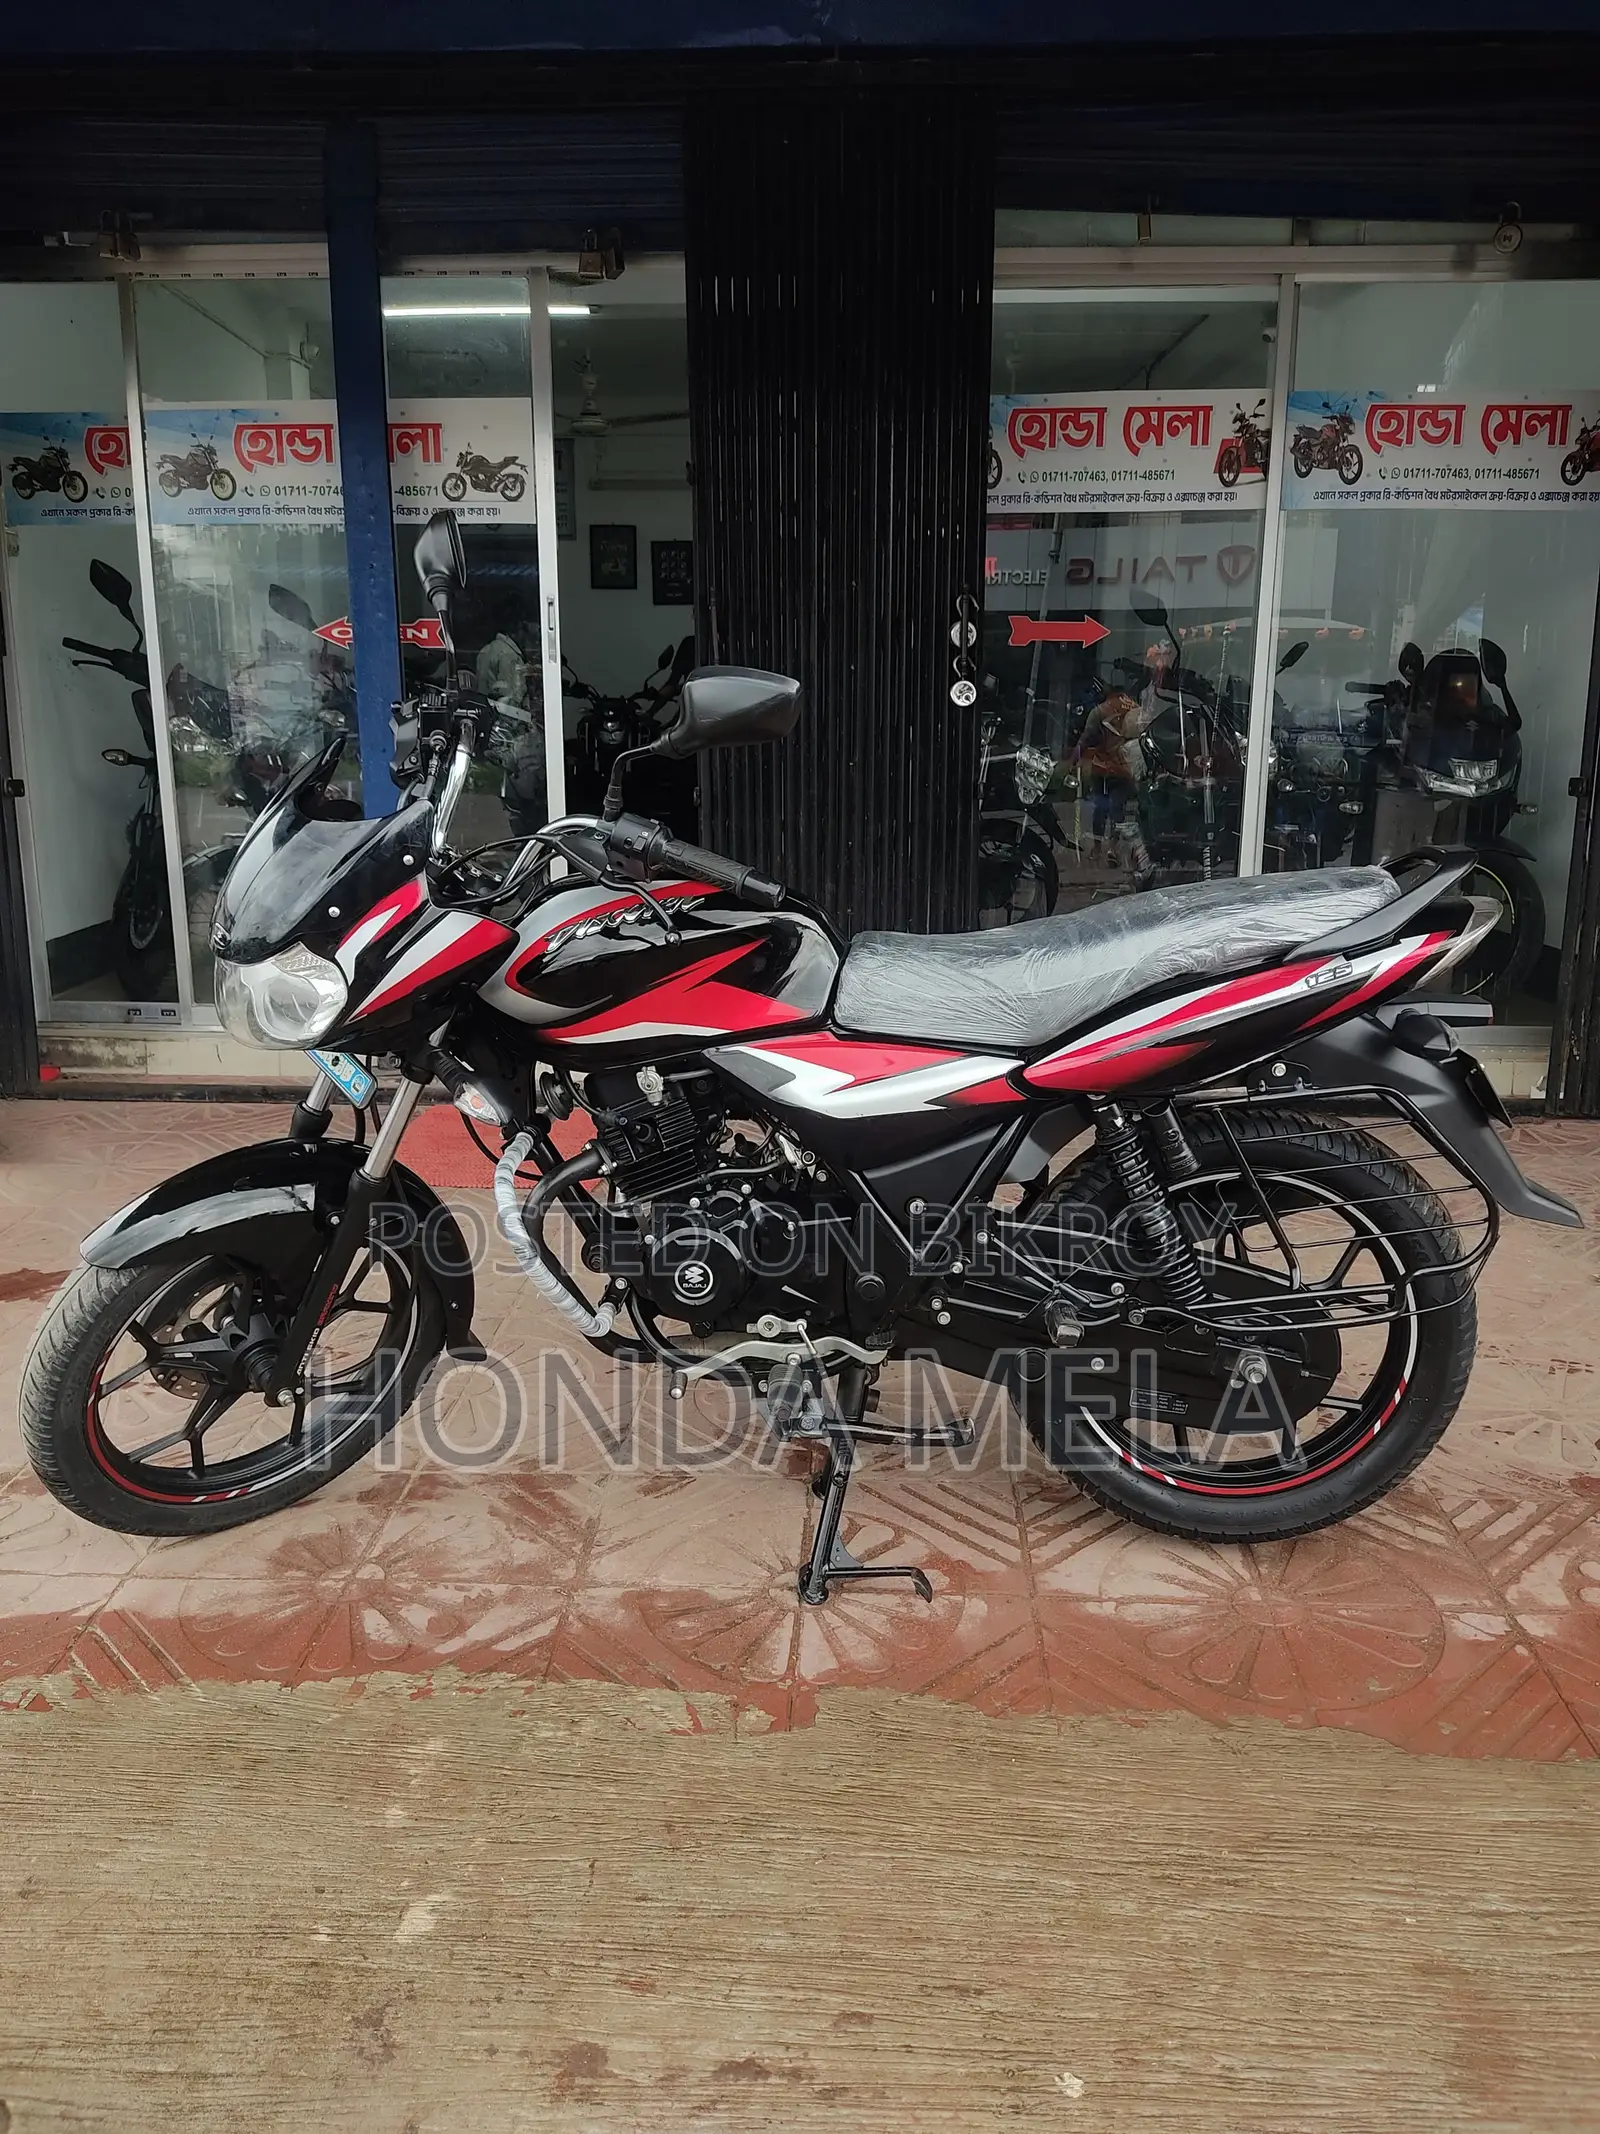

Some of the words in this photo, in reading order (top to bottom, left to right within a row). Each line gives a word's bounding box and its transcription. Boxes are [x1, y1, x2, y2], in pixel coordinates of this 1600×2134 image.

[233, 423, 334, 474] হোন্ডা
[387, 423, 442, 464] লা
[1008, 407, 1107, 459] হোন্ডা
[1123, 405, 1213, 457] মেলা
[1365, 404, 1466, 455] হোন্ডা
[1481, 404, 1572, 455] মেলা
[1111, 469, 1176, 481] 01711-485671
[1474, 468, 1540, 480] 01711-485671
[1305, 961, 1354, 989] 125
